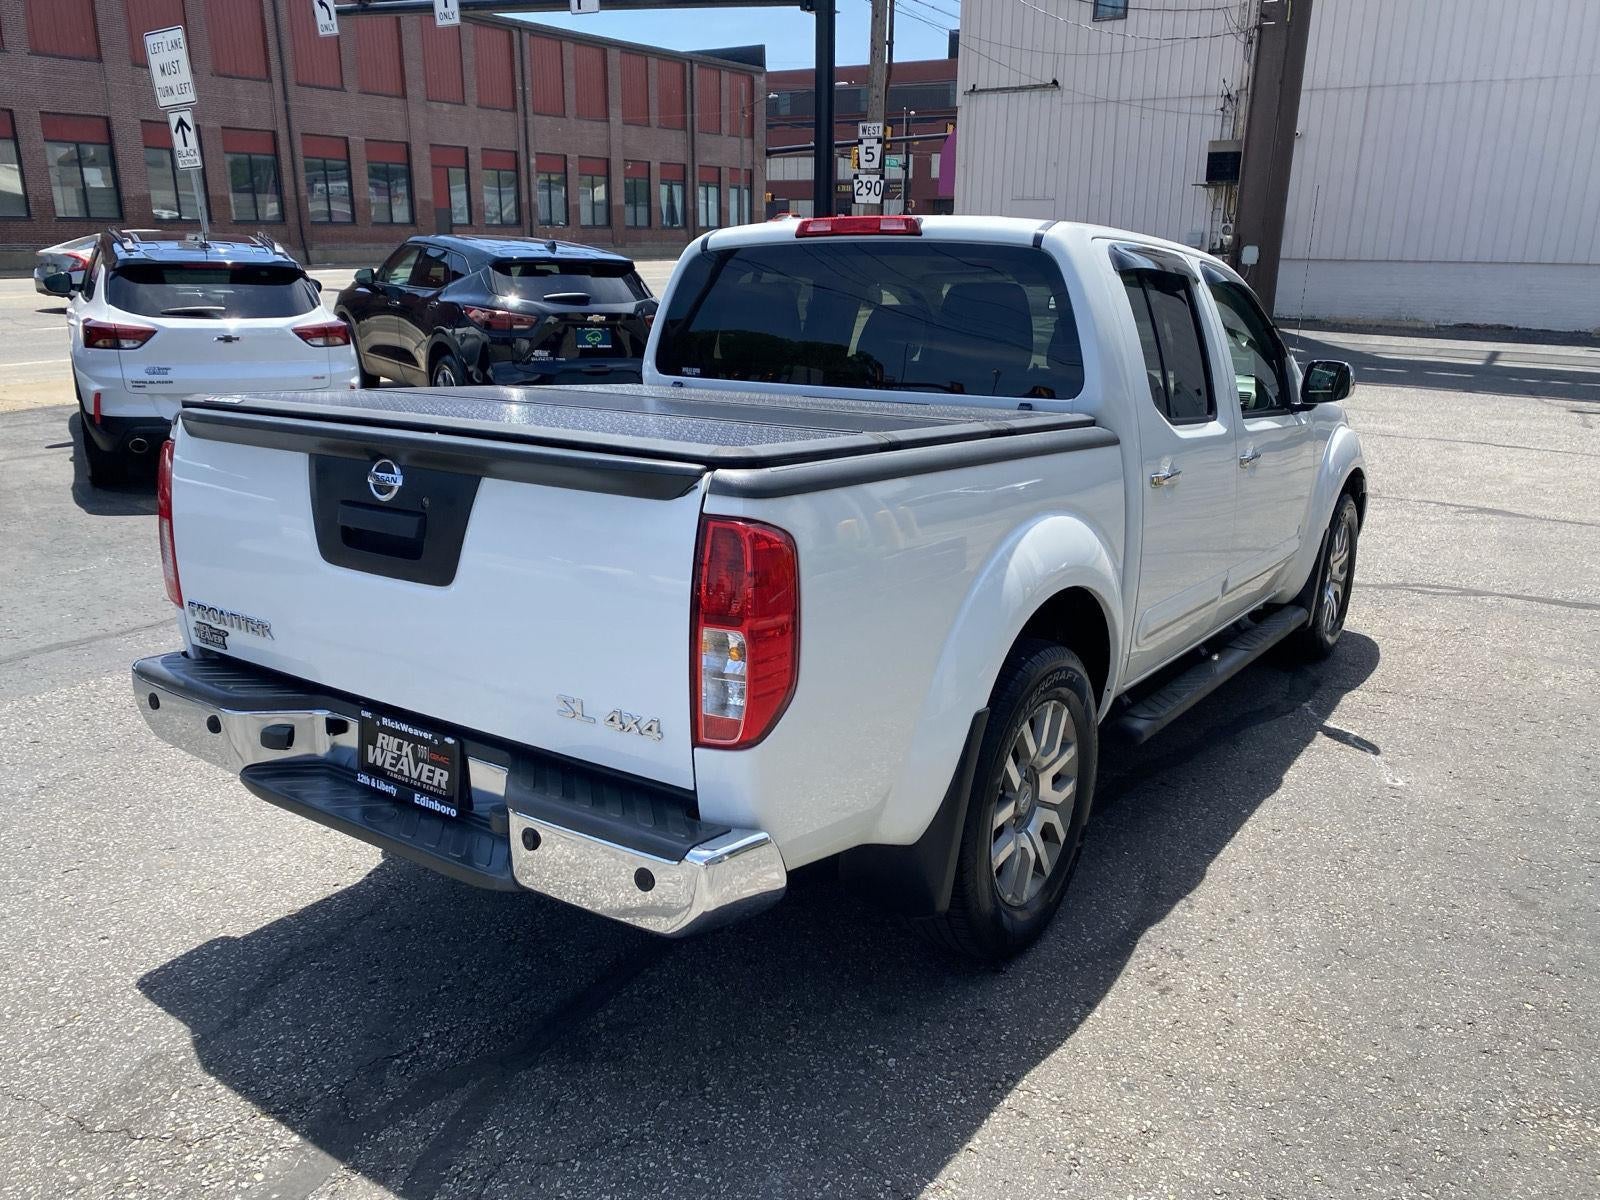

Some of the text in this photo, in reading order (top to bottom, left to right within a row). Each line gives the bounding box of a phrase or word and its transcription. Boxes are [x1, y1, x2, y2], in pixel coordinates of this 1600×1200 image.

[439, 10, 456, 20] ONLY
[319, 23, 335, 32] ONLY
[150, 37, 183, 55] LEFT LANE
[159, 59, 182, 77] MUST
[157, 81, 193, 98] TURN LEFT
[860, 125, 881, 136] WEST
[177, 149, 198, 159] BLACK
[864, 146, 875, 162] 5
[855, 180, 881, 197] 290
[187, 600, 275, 641] FRONTIER
[556, 693, 596, 725] SL
[381, 717, 434, 741] RickWeaver
[376, 732, 416, 758] RICK
[367, 744, 449, 790] WEAVER
[357, 772, 398, 797] 12th & Liberty
[413, 793, 458, 818] Edinboro
